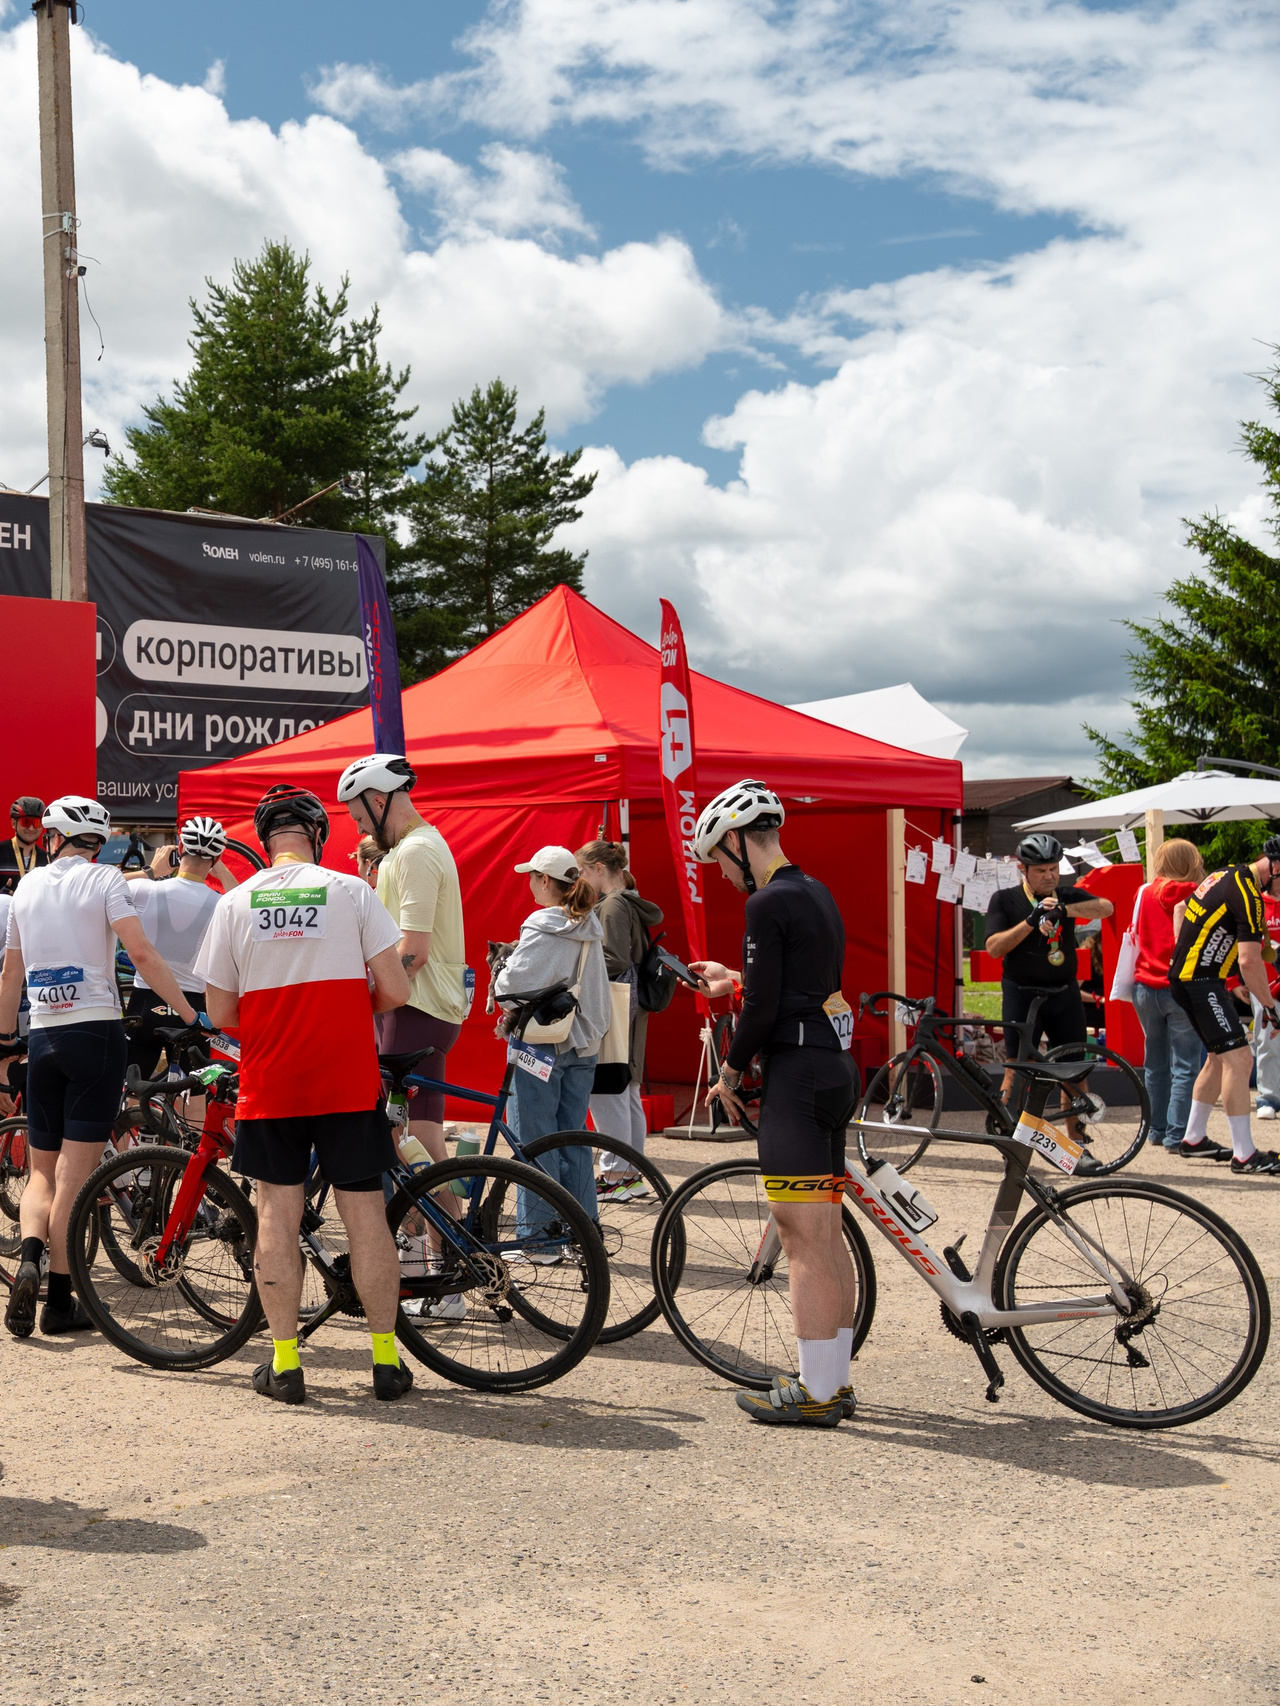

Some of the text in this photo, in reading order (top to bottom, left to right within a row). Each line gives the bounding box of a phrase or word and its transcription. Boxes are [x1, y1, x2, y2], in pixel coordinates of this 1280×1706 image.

[249, 552, 285, 565] volen.ru
[136, 635, 362, 680] корпоративы
[129, 709, 324, 752] дни рожде
[97, 780, 151, 797] ваших
[259, 906, 318, 930] 3042
[38, 984, 80, 1004] 4012
[518, 1052, 536, 1067] 4069
[1030, 1130, 1057, 1152] 2239
